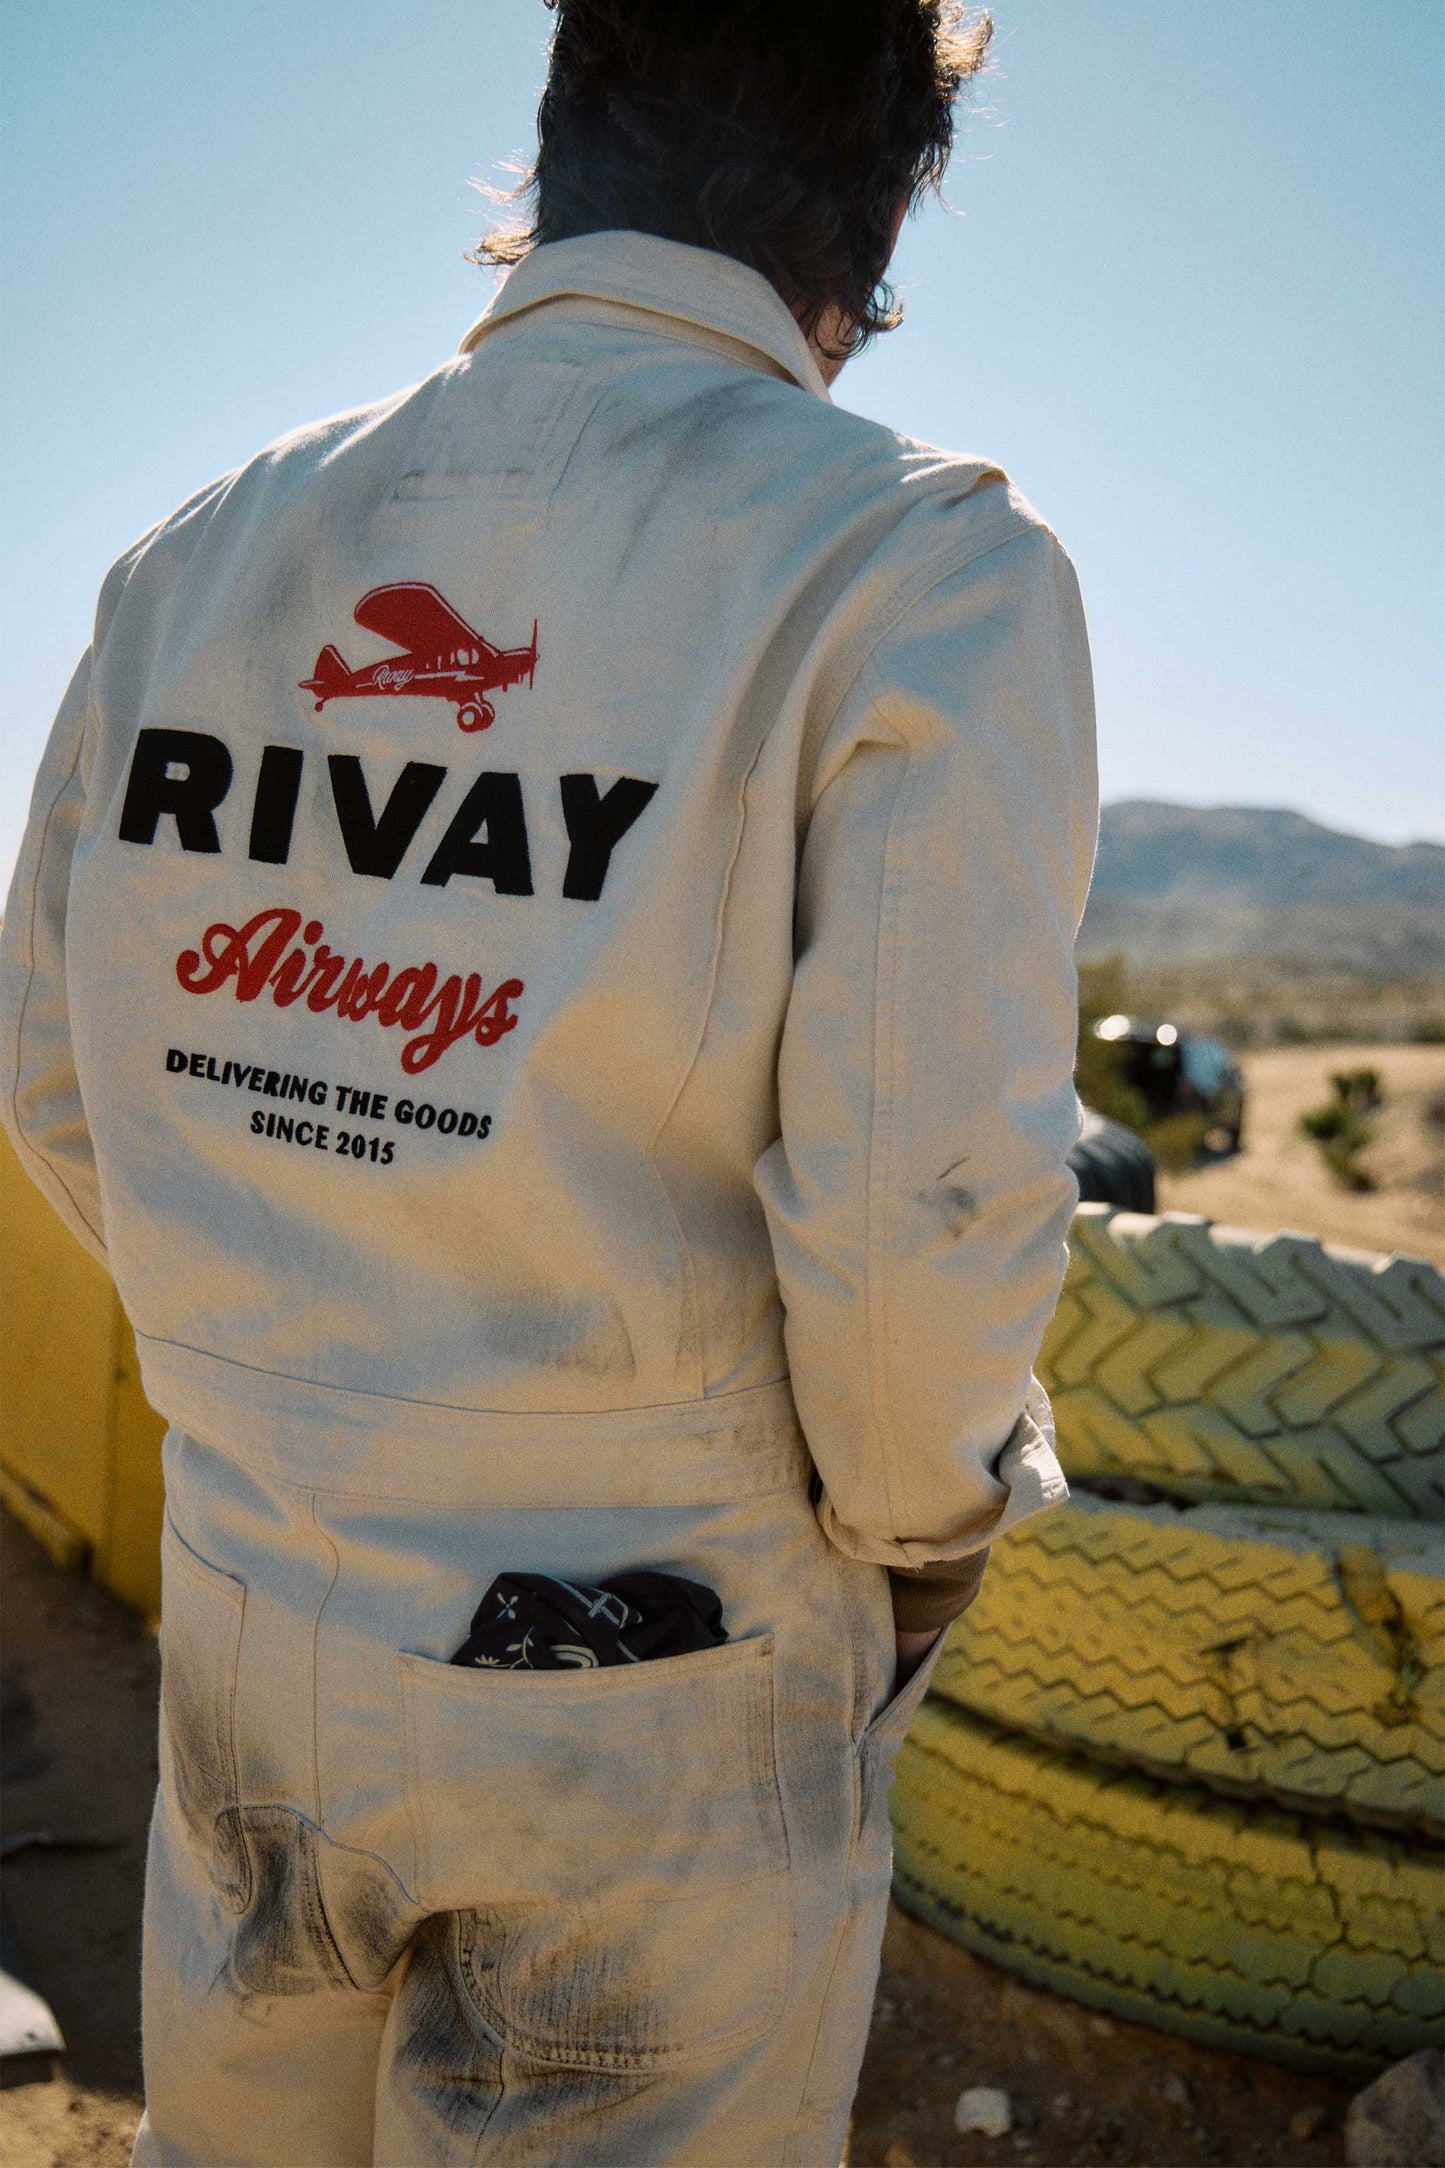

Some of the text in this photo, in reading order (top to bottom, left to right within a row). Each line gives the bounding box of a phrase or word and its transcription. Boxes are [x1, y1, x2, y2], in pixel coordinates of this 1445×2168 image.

[372, 664, 414, 691] Rivay
[118, 728, 659, 901] RIVAY
[176, 908, 524, 1074] Airways
[166, 1049, 492, 1140] DELIVERING THE GOODS
[250, 1110, 395, 1165] SINCE 2015
